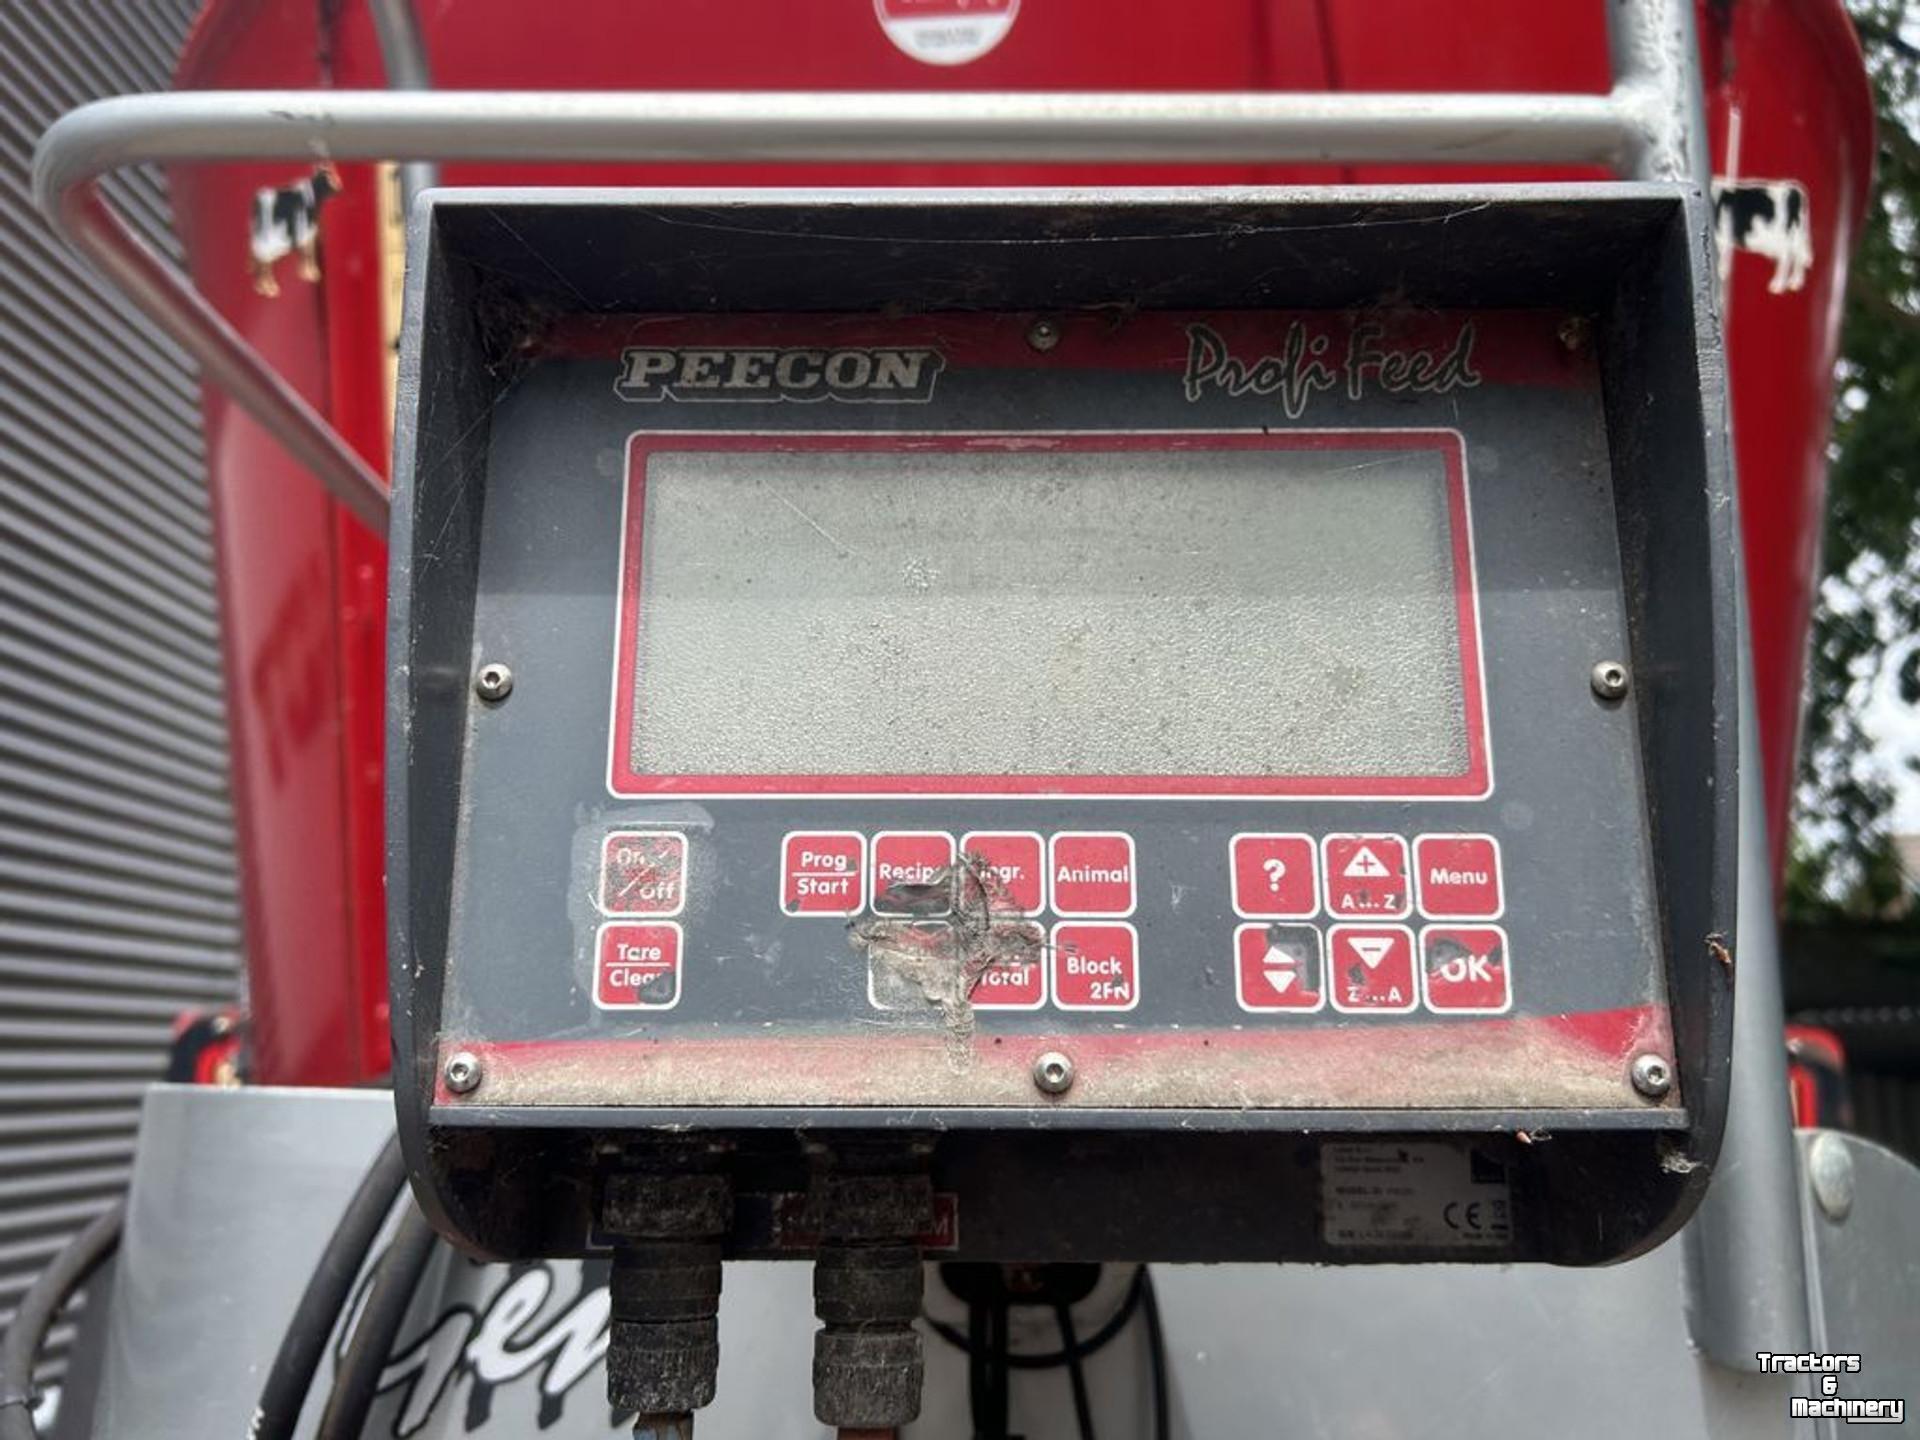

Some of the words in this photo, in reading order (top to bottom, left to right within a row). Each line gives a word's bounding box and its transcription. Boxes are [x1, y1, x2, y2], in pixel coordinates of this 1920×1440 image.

[618, 350, 934, 391] PEECON
[1182, 321, 1336, 419] Profi
[1345, 320, 1481, 400] Feed
[800, 851, 847, 873] Prog
[879, 862, 941, 884] Recip
[1056, 865, 1129, 883] Animal
[1263, 858, 1287, 893] ?
[1429, 867, 1489, 885] Menu
[796, 877, 849, 895] Start
[1066, 955, 1123, 975] Block
[1440, 954, 1493, 983] OK
